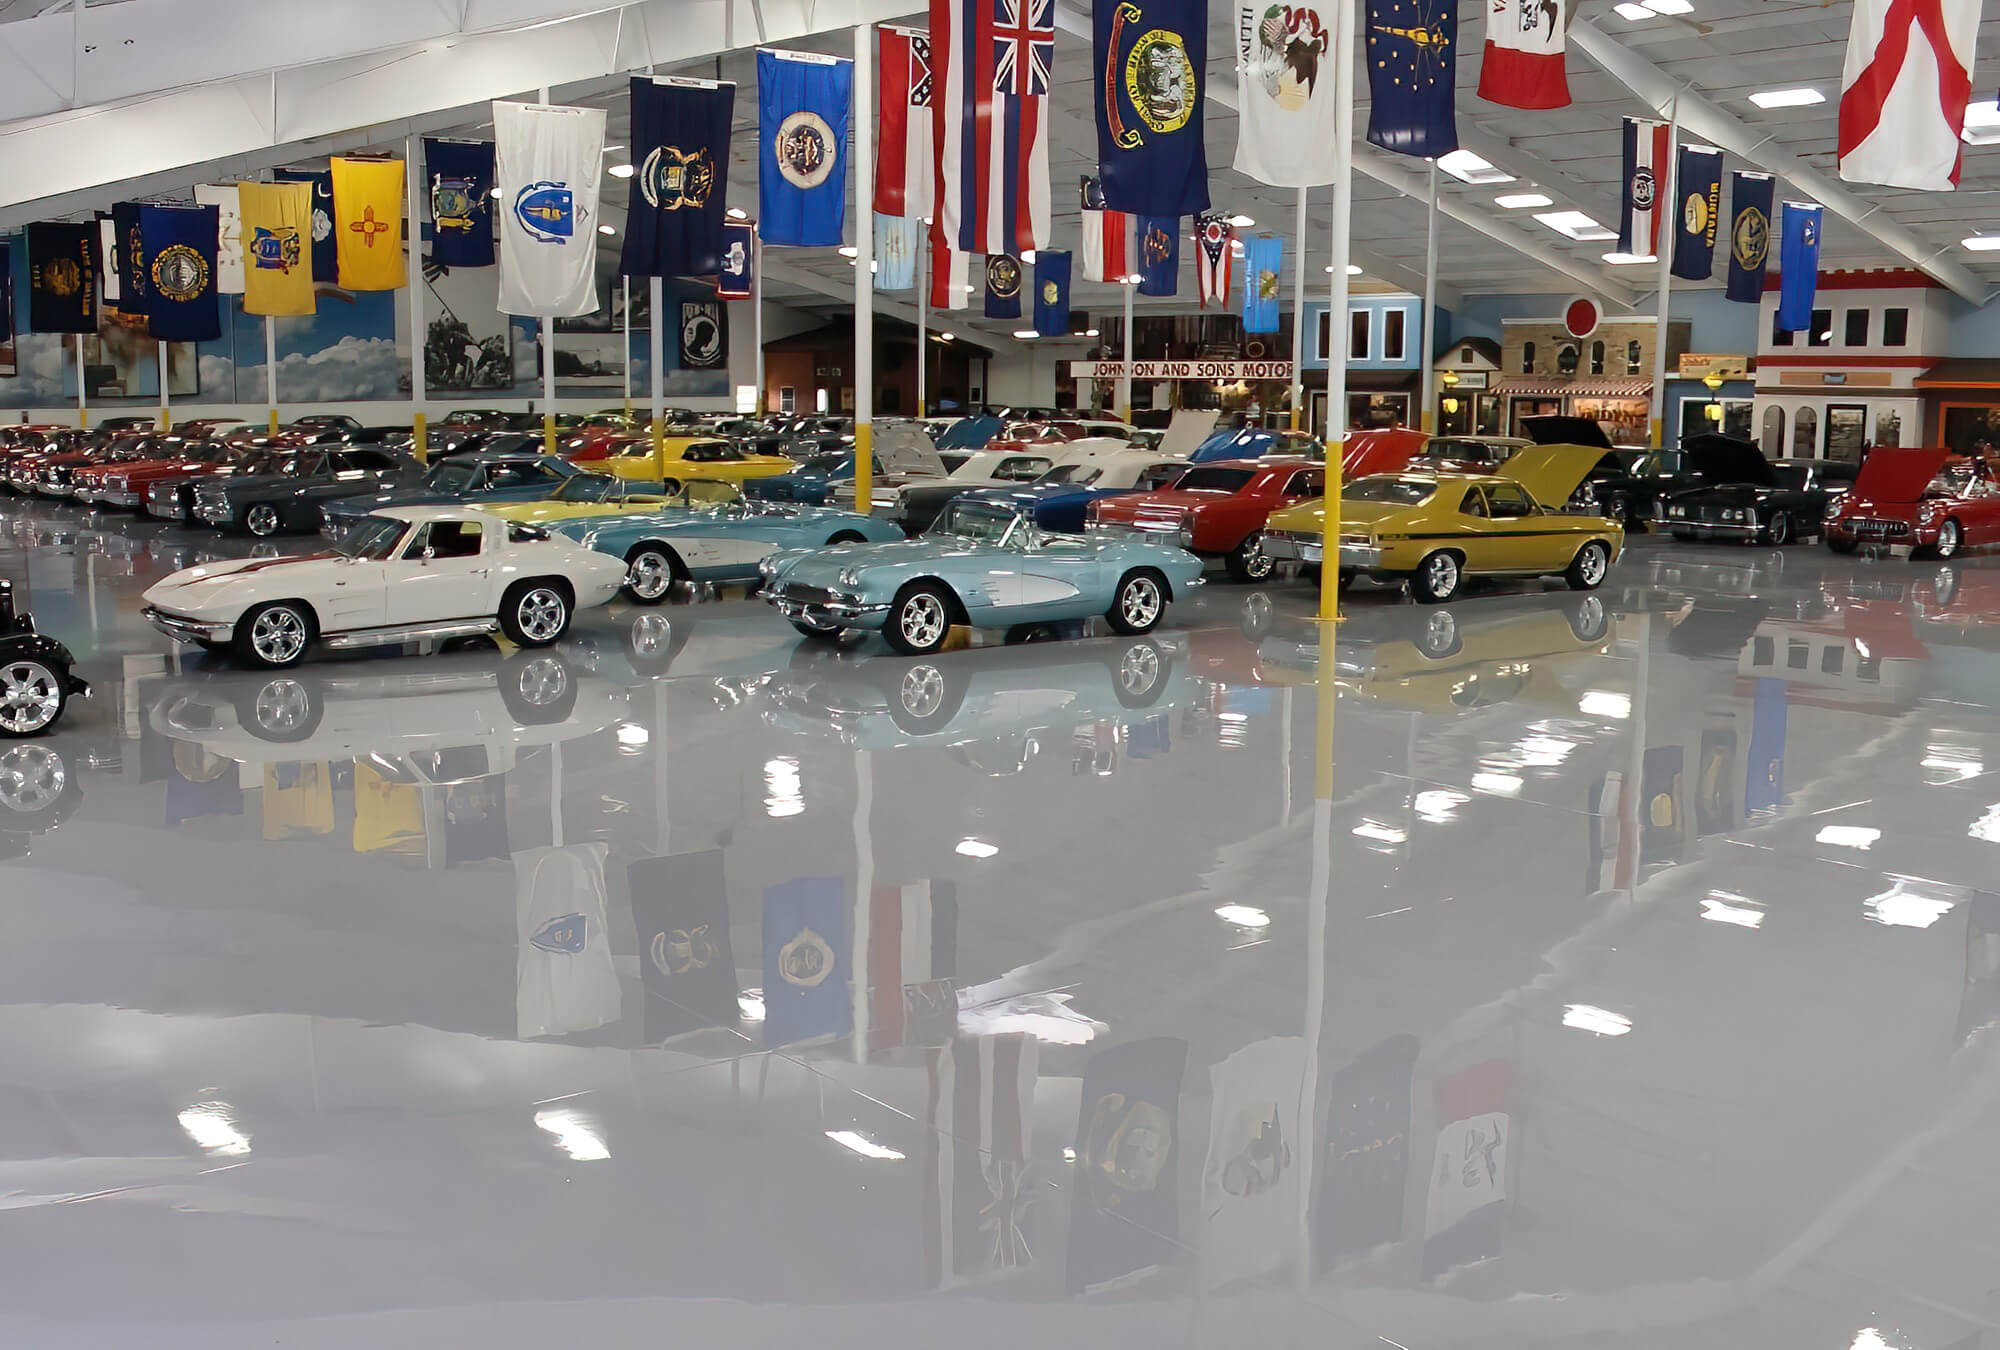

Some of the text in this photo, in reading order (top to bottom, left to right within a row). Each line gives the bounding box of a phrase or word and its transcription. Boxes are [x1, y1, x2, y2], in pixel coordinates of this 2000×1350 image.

[1093, 363, 1155, 377] JOHNON
[1162, 363, 1190, 377] AND
[1197, 363, 1235, 377] SONS
